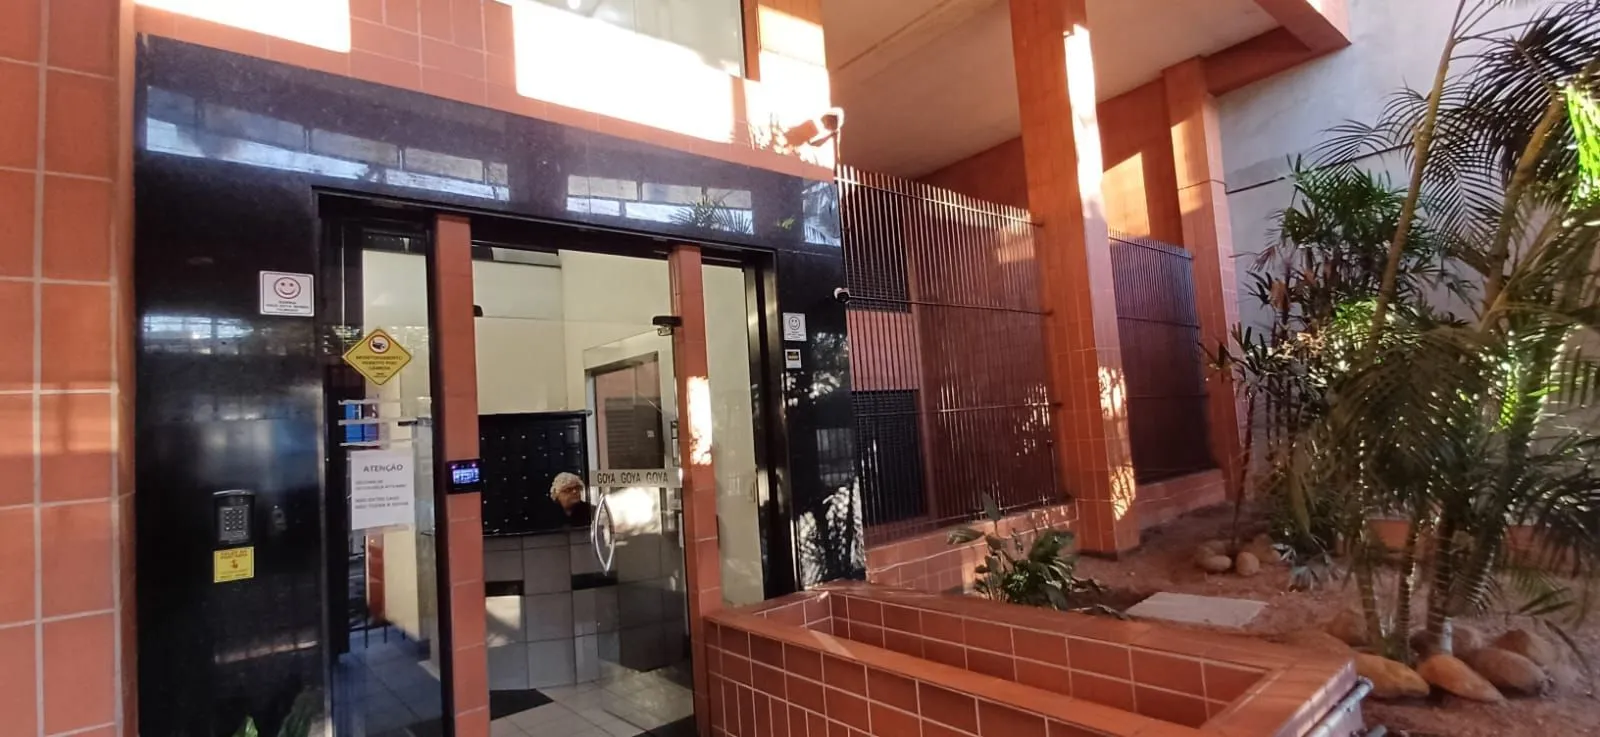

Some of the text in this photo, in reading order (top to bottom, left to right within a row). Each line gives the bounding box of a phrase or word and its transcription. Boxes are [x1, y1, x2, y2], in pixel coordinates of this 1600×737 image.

[363, 463, 404, 473] ATENÇÃO
[597, 471, 669, 484] GOYA GOYA GOYA
